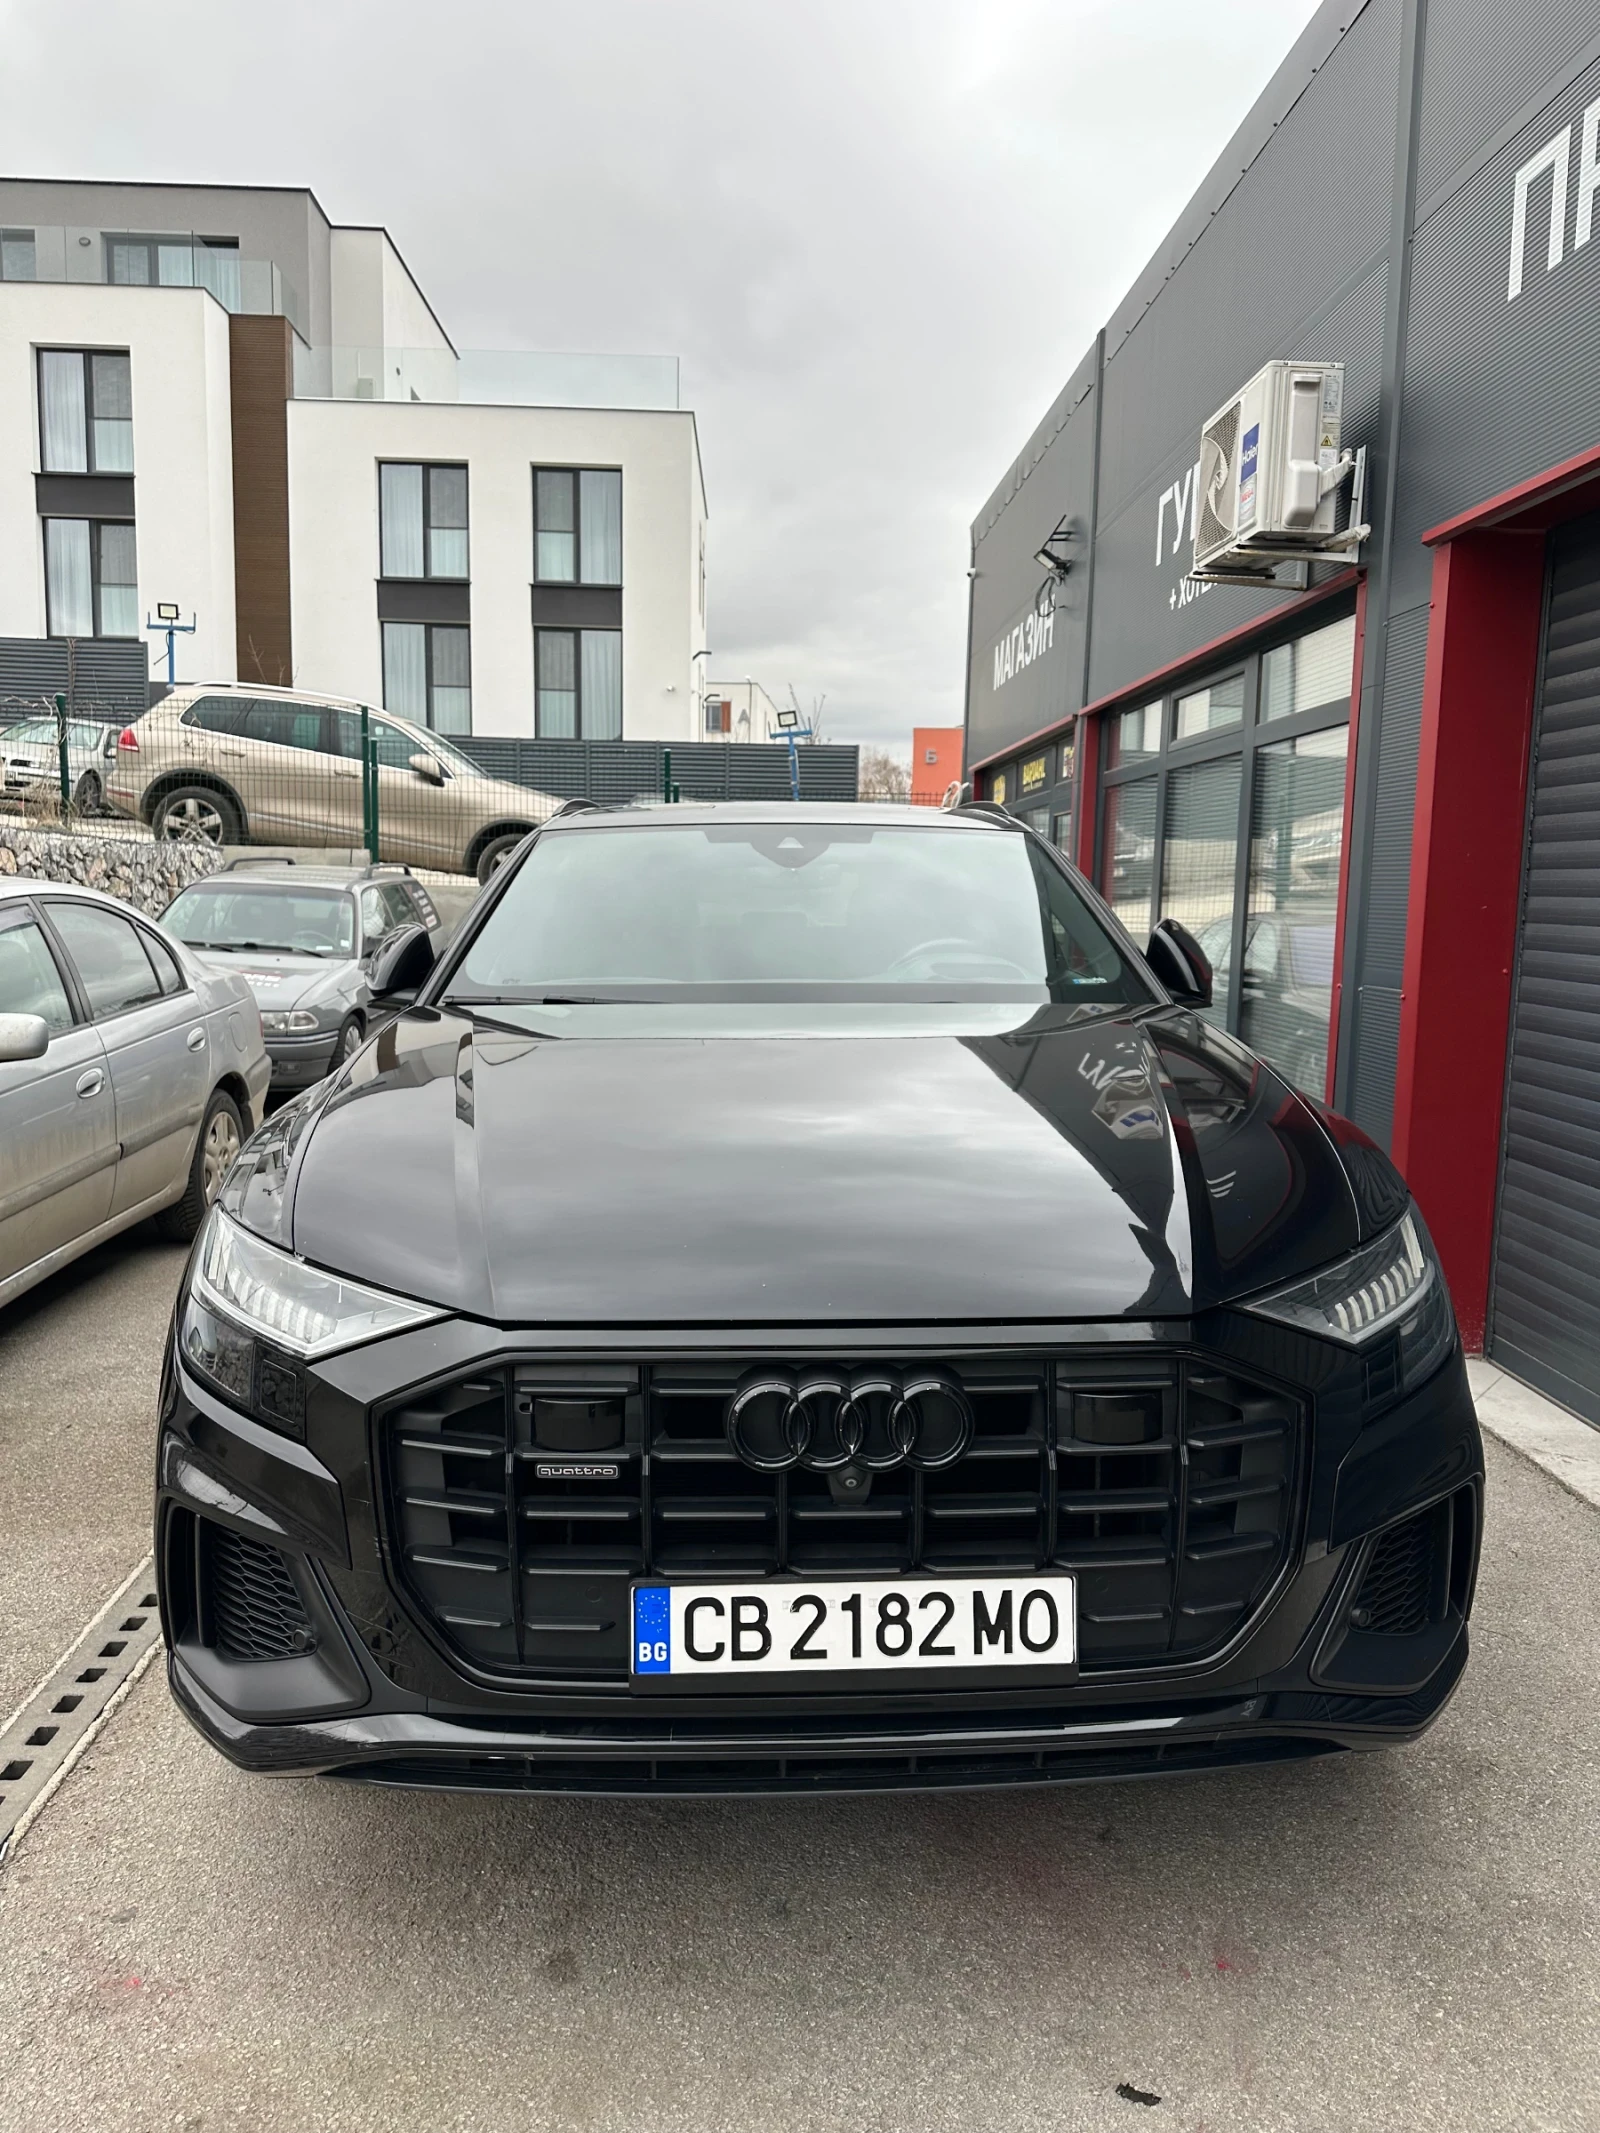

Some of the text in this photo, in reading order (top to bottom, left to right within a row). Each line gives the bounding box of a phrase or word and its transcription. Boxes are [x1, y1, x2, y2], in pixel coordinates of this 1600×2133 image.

[1155, 460, 1201, 567] ГУ
[993, 593, 1056, 691] МАГАЗИН
[540, 1467, 614, 1476] quattro
[638, 1642, 668, 1662] BG
[684, 1588, 1059, 1662] CB 2182 MO
